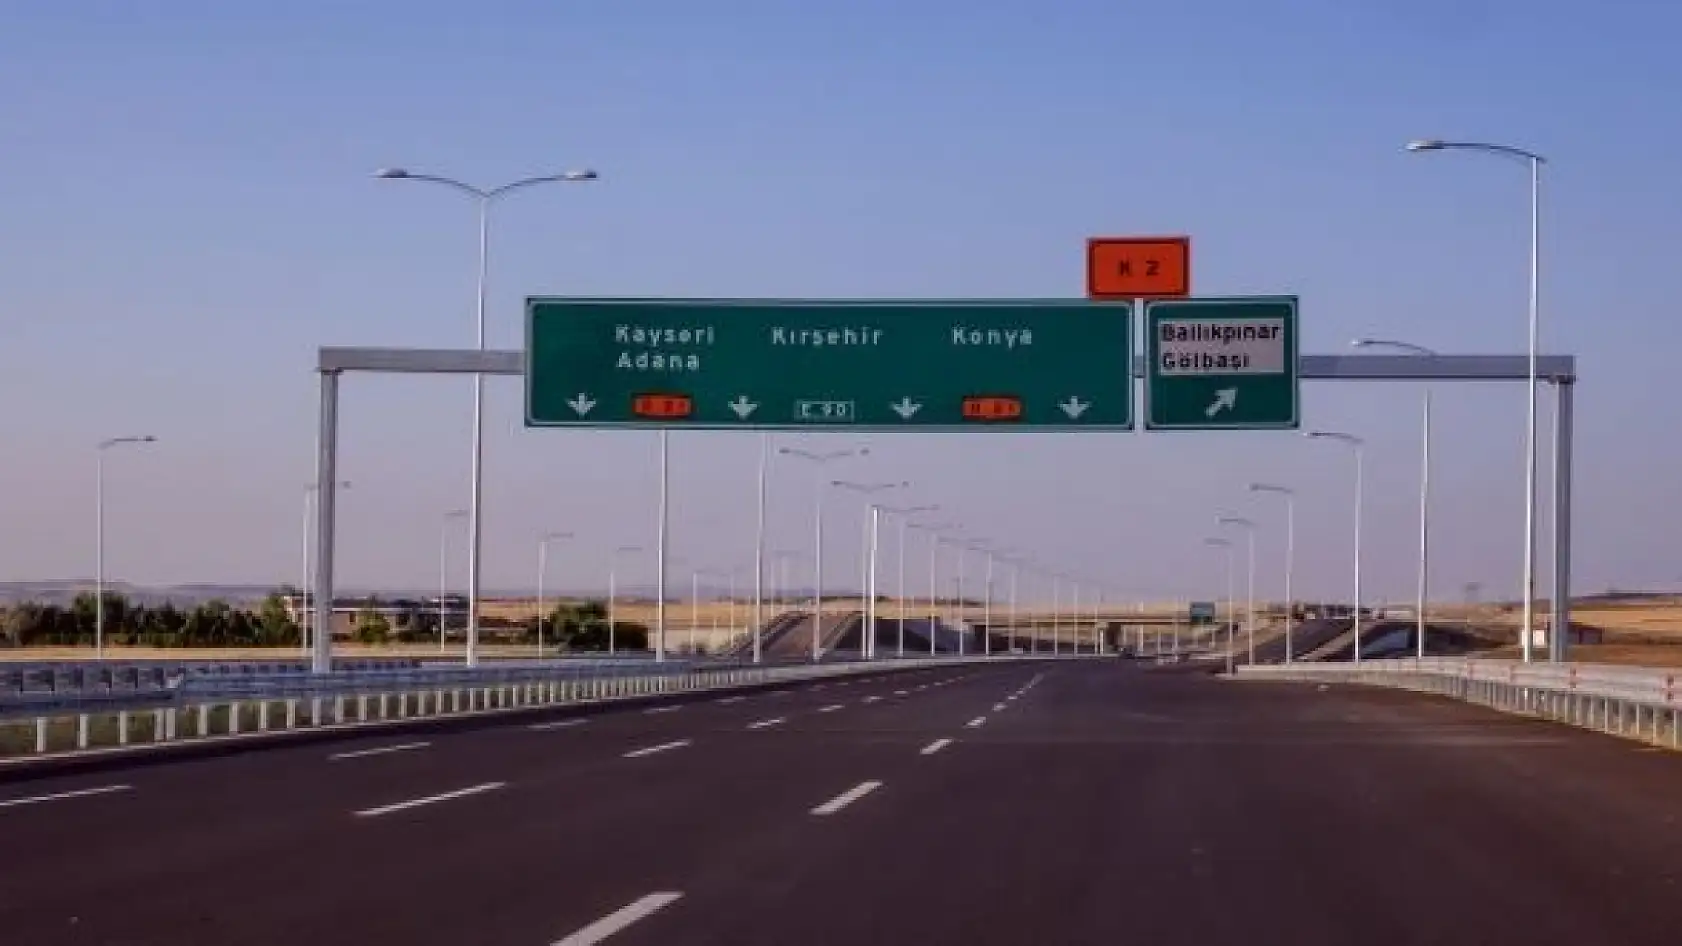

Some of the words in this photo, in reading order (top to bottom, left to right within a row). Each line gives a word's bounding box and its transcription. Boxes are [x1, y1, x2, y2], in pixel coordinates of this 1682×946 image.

[615, 325, 715, 347] Kayseri
[952, 326, 1033, 350] Konya
[616, 352, 700, 370] Adana
